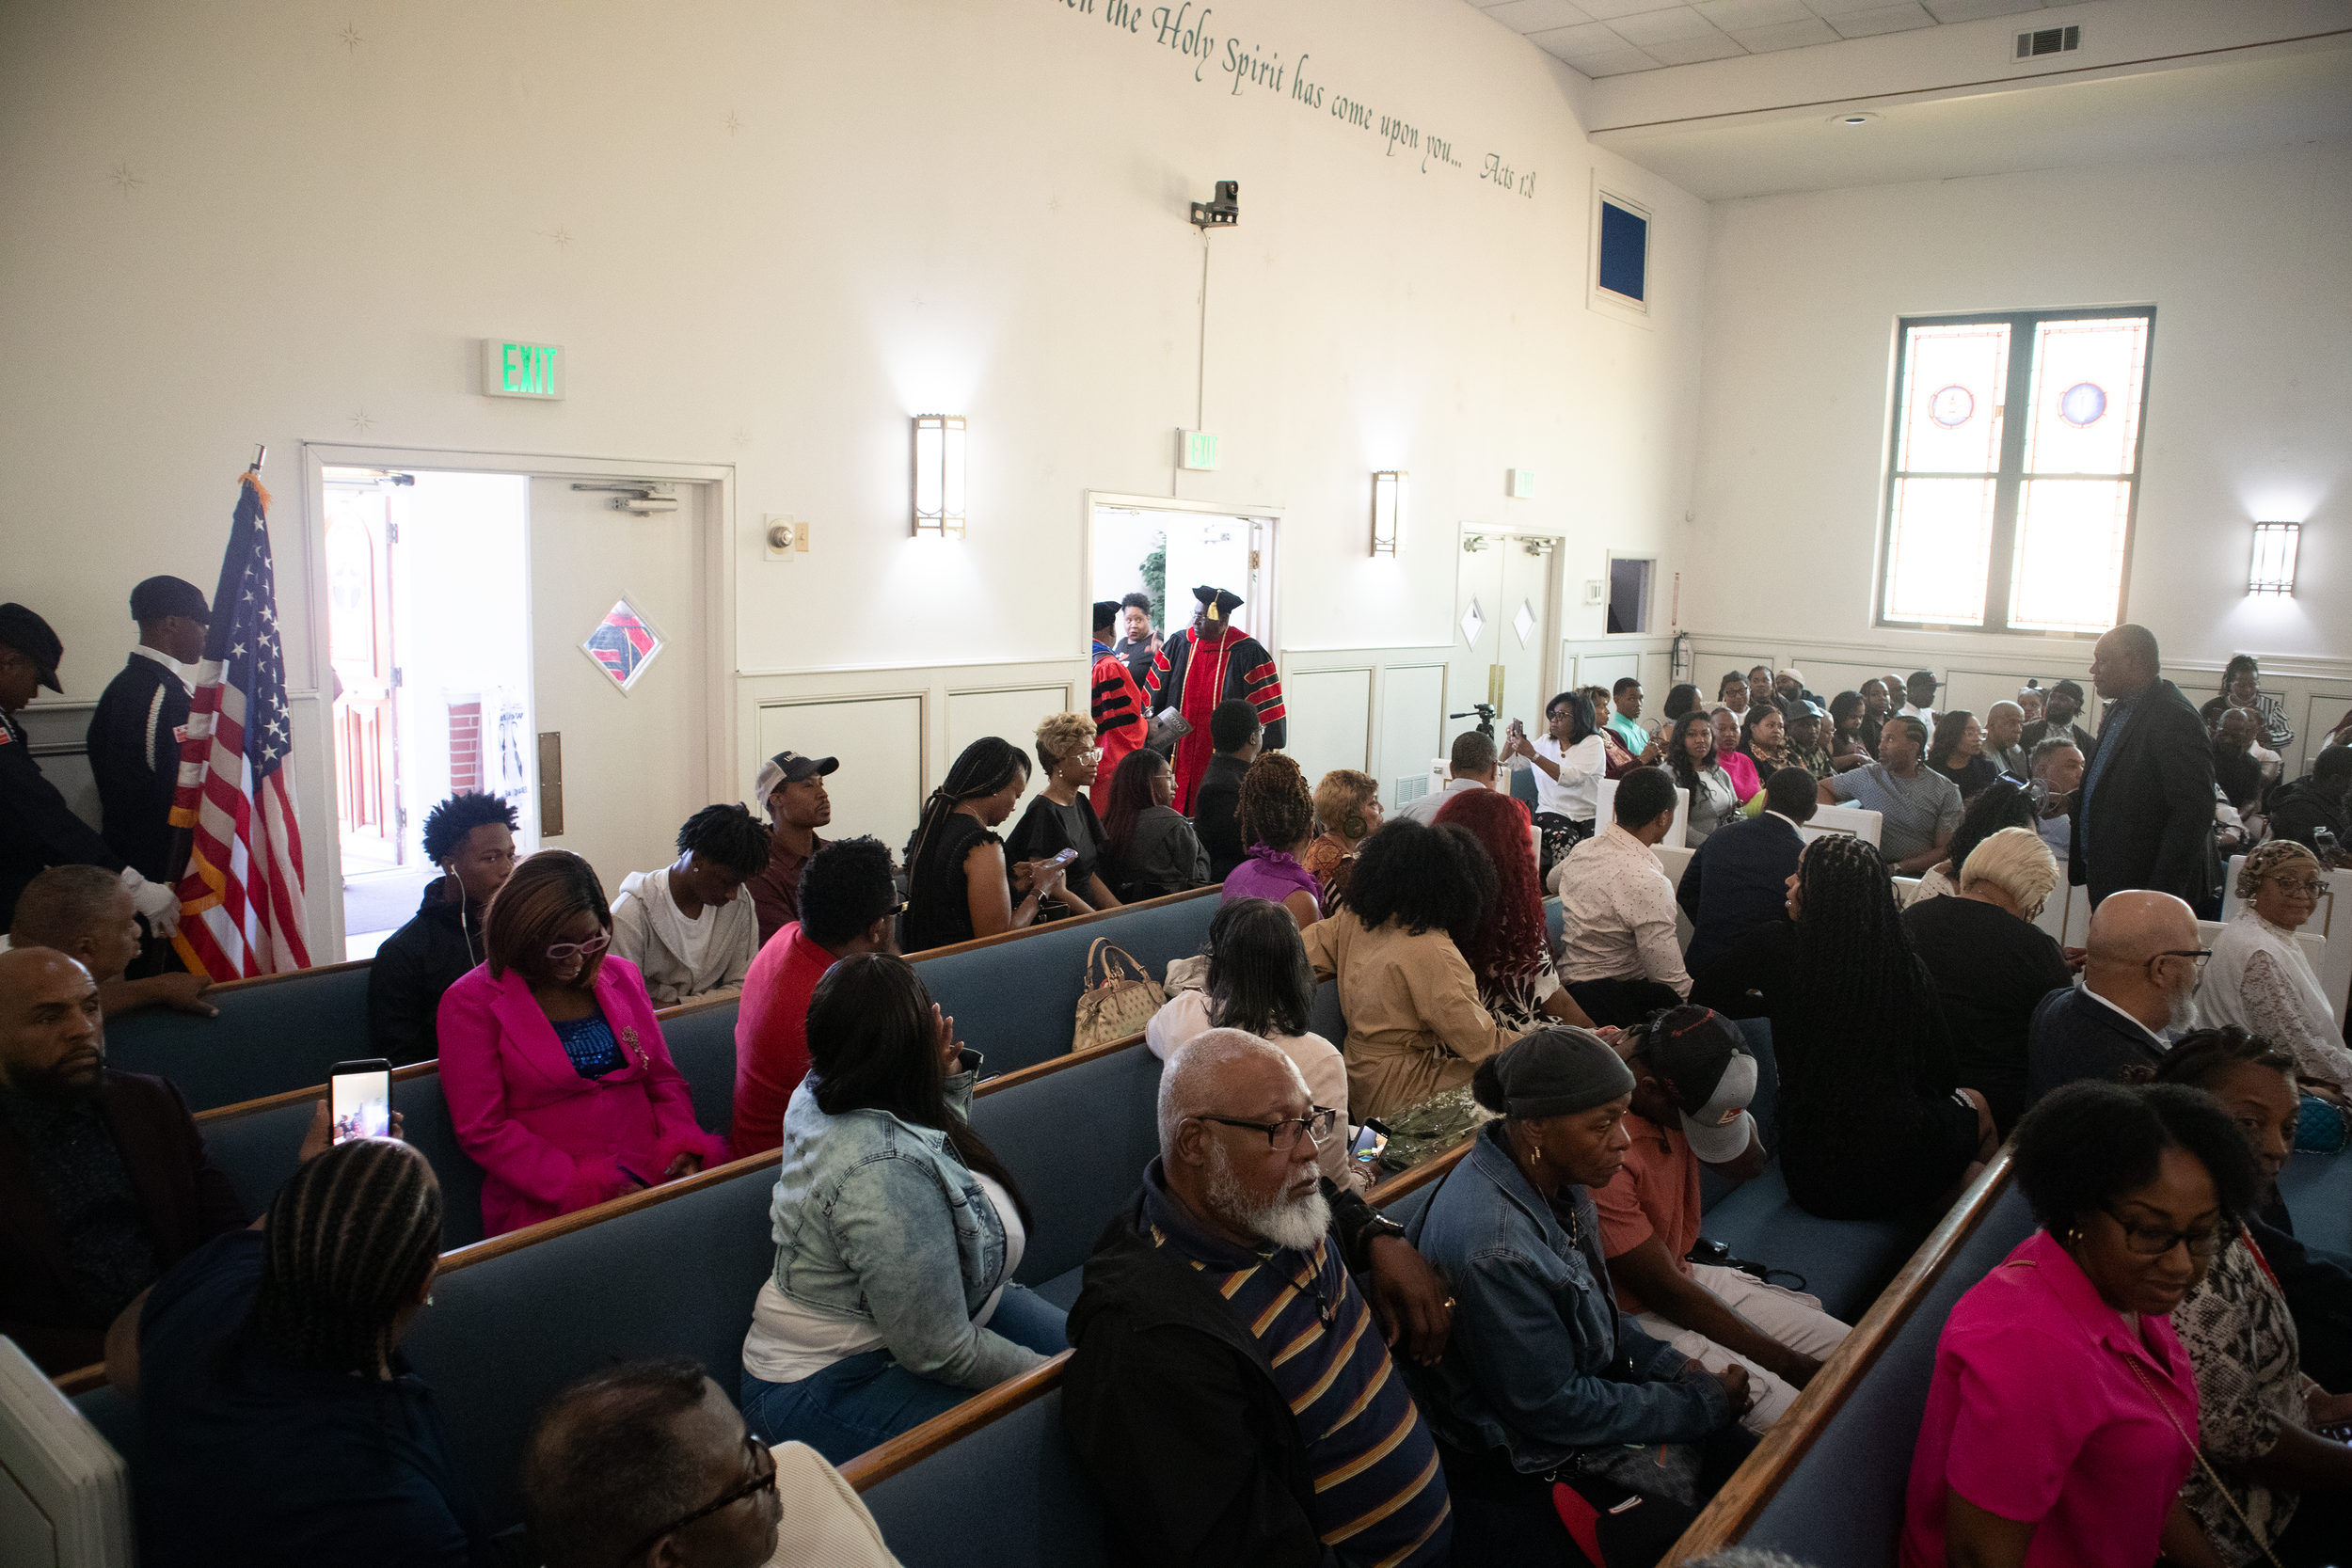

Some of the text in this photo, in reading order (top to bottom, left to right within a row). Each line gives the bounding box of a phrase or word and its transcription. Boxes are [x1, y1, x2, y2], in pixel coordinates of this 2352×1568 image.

[1106, 0, 1536, 199] the Holy Spirit has come upon you... Acts 1:8
[502, 343, 557, 395] EXIT
[1191, 434, 1217, 467] EXIT
